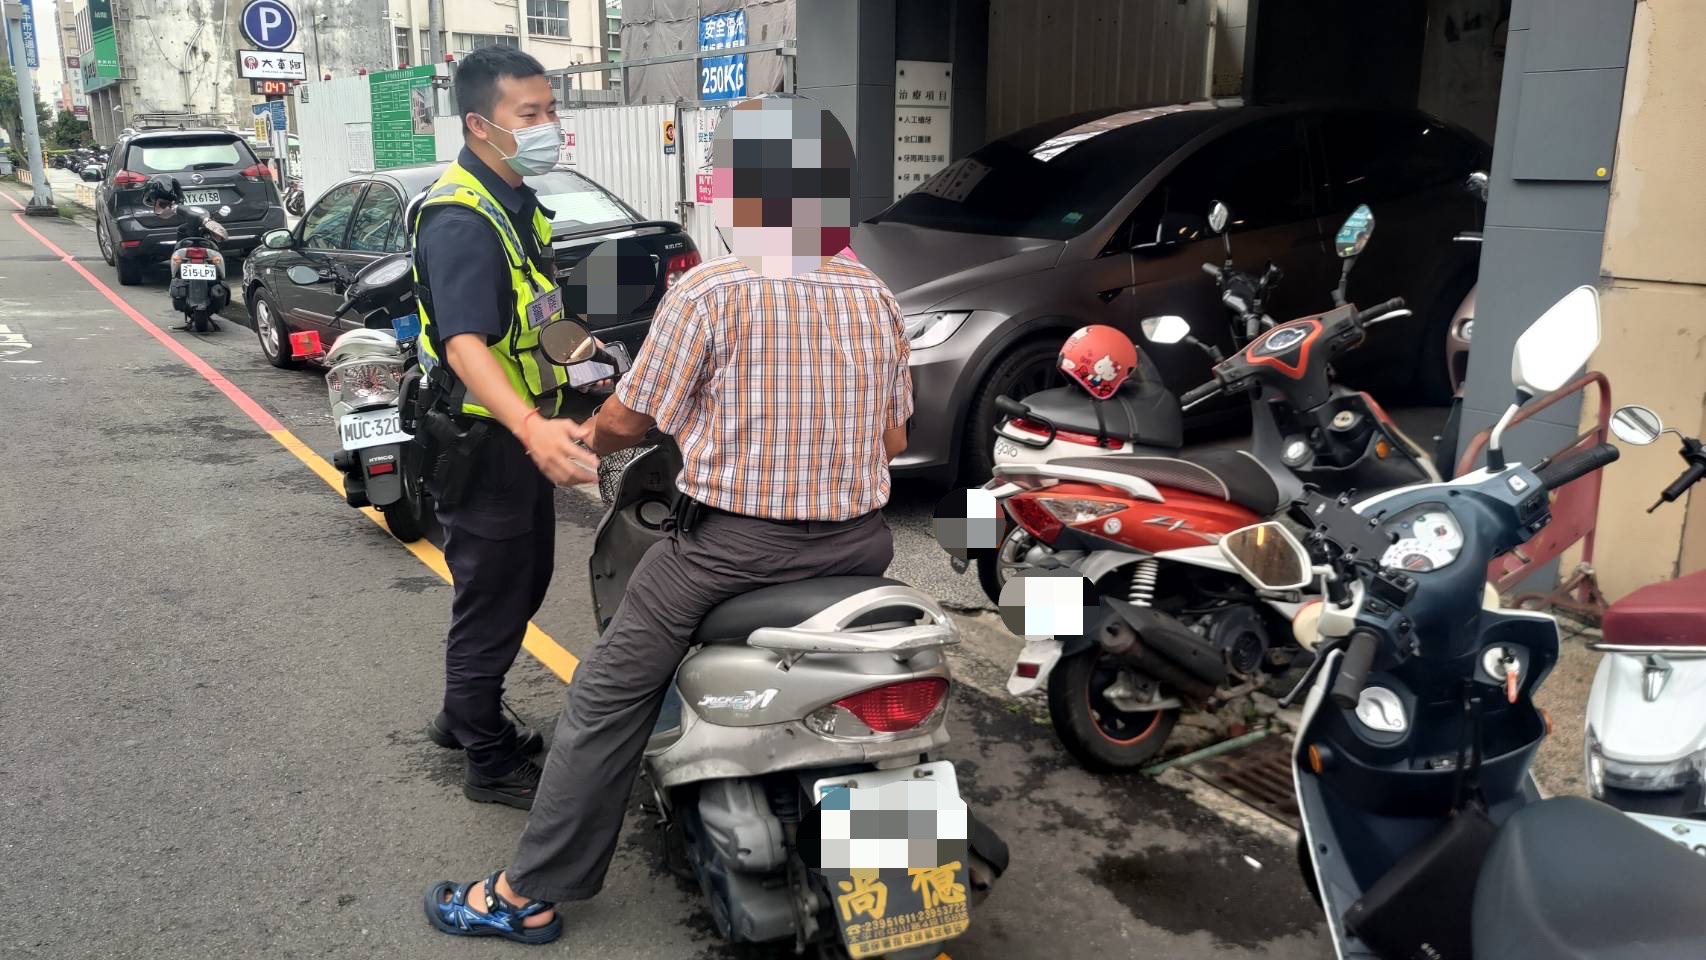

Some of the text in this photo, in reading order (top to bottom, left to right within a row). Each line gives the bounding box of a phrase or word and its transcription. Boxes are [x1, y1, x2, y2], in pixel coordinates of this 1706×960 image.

[259, 7, 282, 41] P
[265, 82, 286, 93] 047
[702, 63, 744, 94] 250KG
[899, 89, 947, 100] 治療項目
